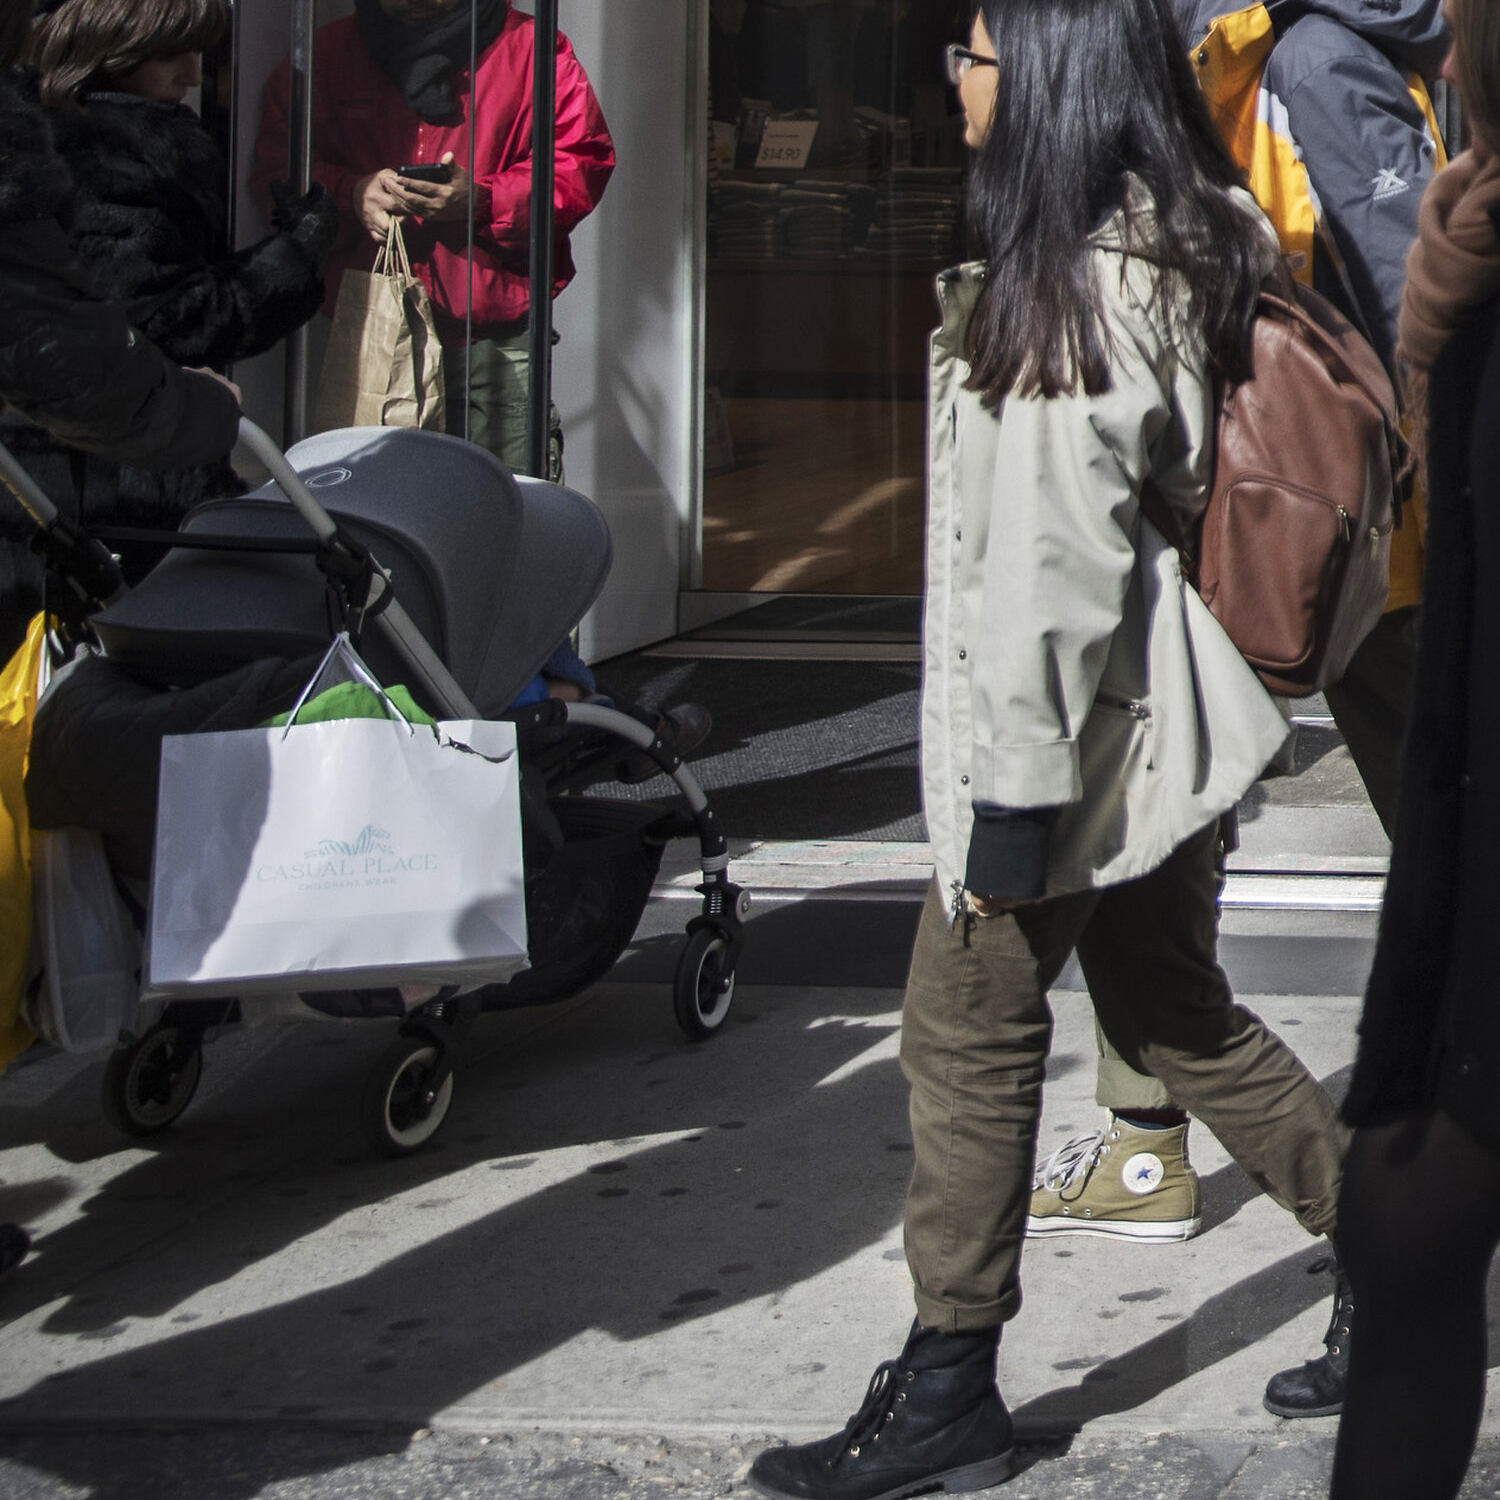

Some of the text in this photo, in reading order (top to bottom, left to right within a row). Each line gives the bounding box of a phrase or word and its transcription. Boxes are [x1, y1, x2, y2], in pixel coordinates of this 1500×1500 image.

[760, 146, 802, 161] $14.90
[257, 854, 438, 882] CASUAL PLACE
